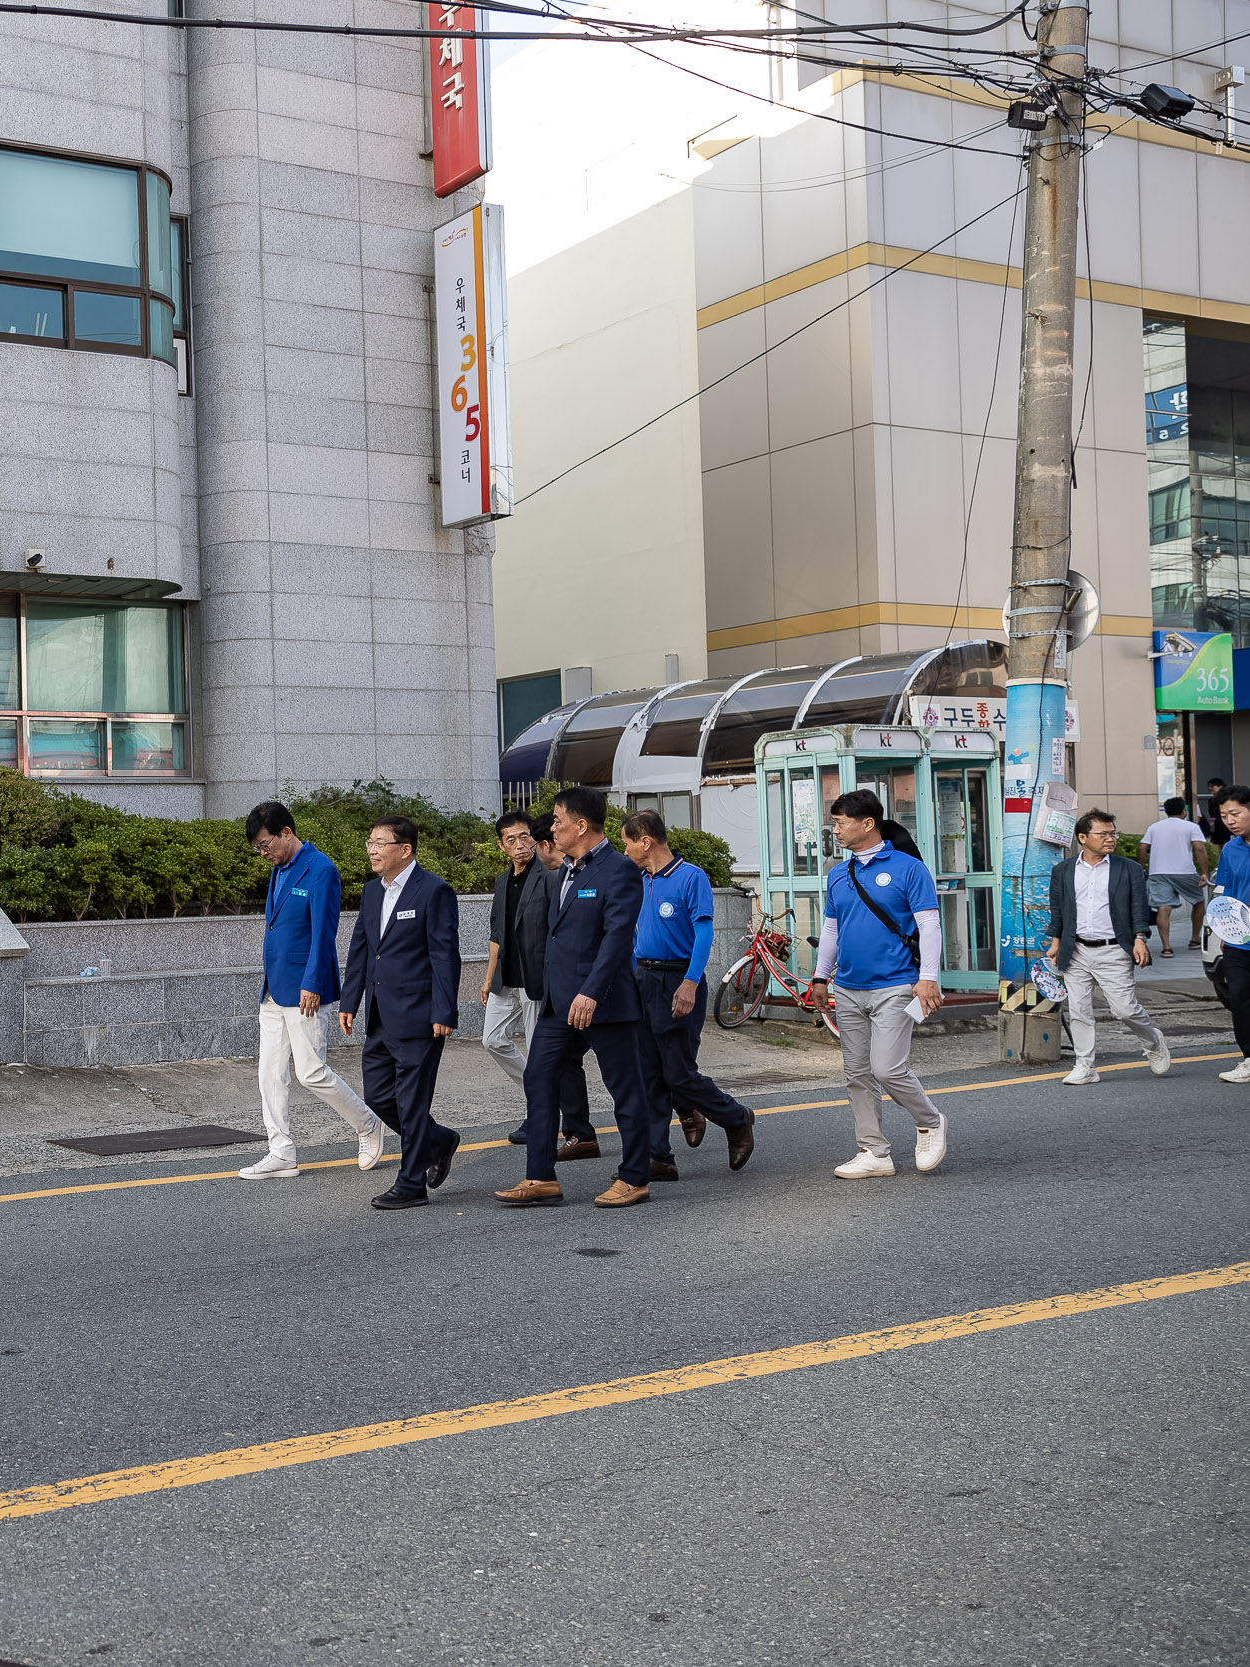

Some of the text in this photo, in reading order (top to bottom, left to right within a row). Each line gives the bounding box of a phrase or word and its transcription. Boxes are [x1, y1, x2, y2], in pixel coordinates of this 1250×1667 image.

[451, 277, 481, 483] 우체국 365 코너
[1196, 666, 1229, 693] 365
[1197, 696, 1230, 704] Auto Bank
[944, 707, 976, 727] 구두
[795, 741, 807, 751] kt
[880, 733, 892, 747] kt
[954, 734, 968, 749] kt
